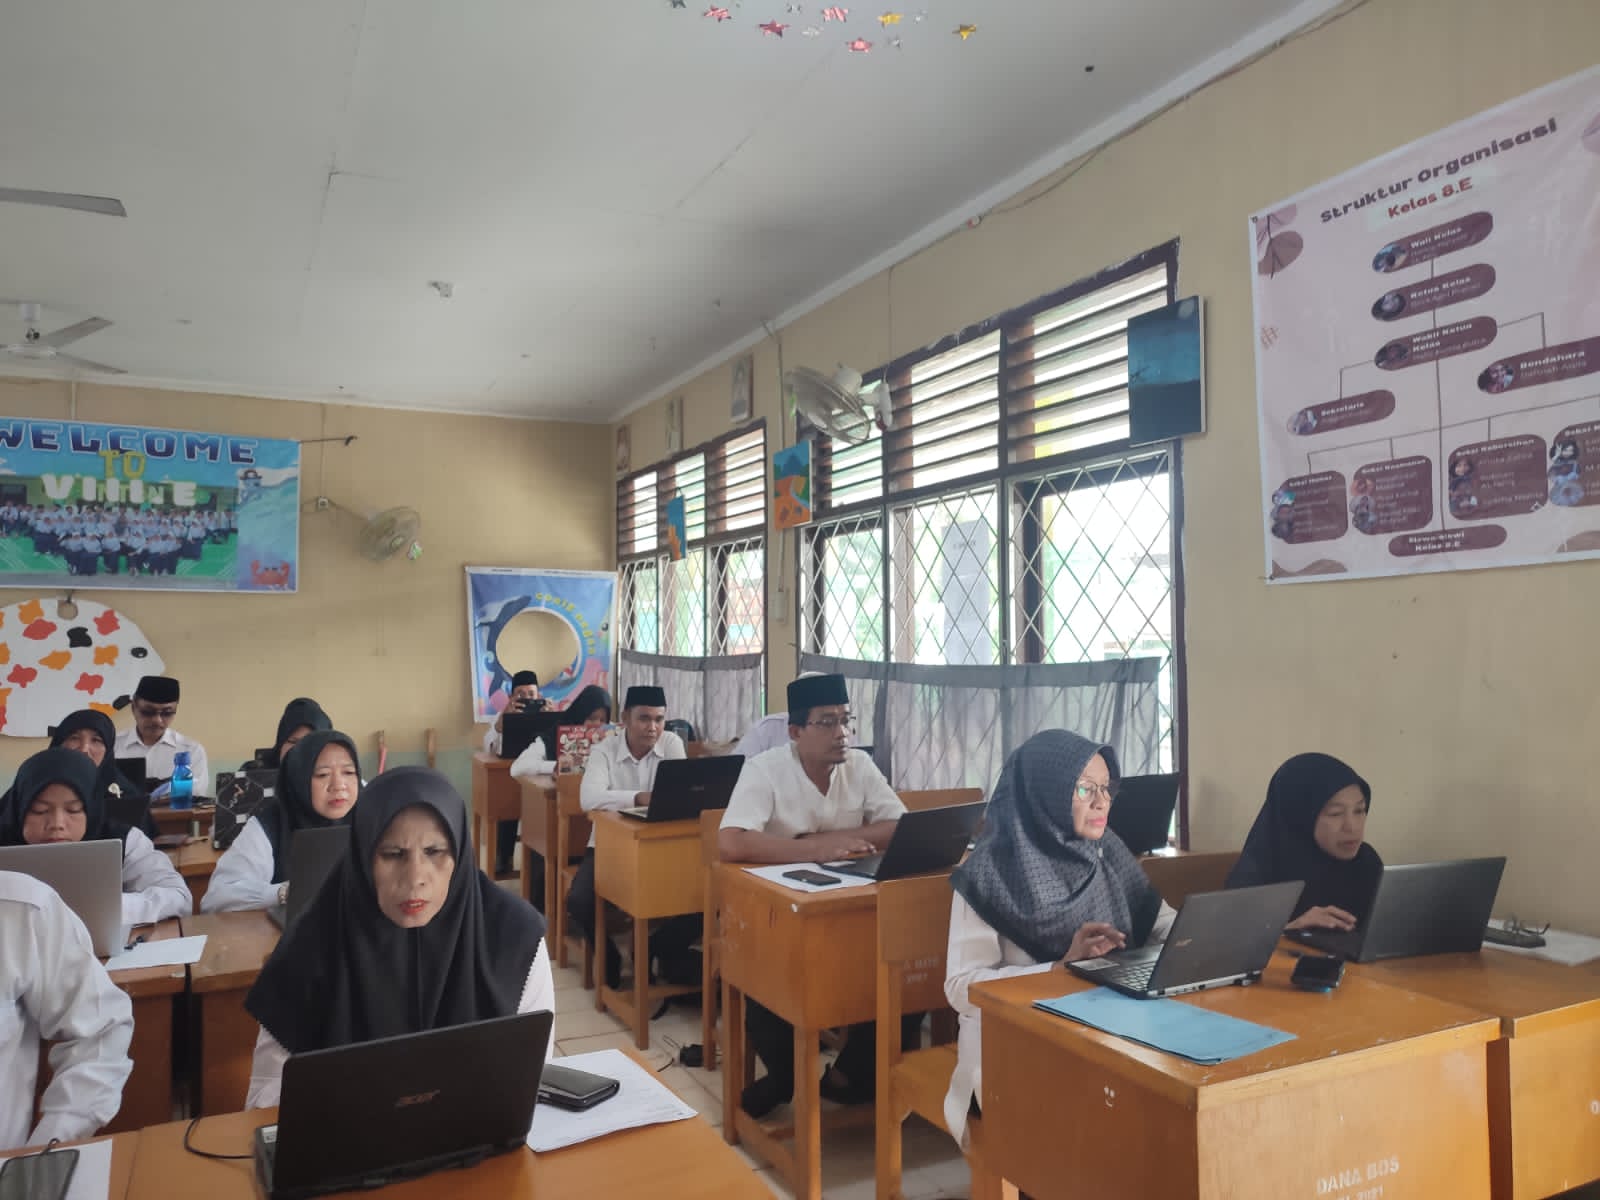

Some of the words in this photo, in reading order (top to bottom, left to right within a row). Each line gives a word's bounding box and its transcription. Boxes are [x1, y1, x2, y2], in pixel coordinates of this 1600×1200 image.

[1320, 176, 1413, 224] Struktur
[1416, 117, 1558, 183] Organisasi
[1387, 192, 1437, 219] Kelas
[1441, 176, 1474, 199] 8.E
[0, 420, 258, 464] WELCOME
[97, 449, 146, 479] TO
[1316, 1166, 1363, 1196] DANA
